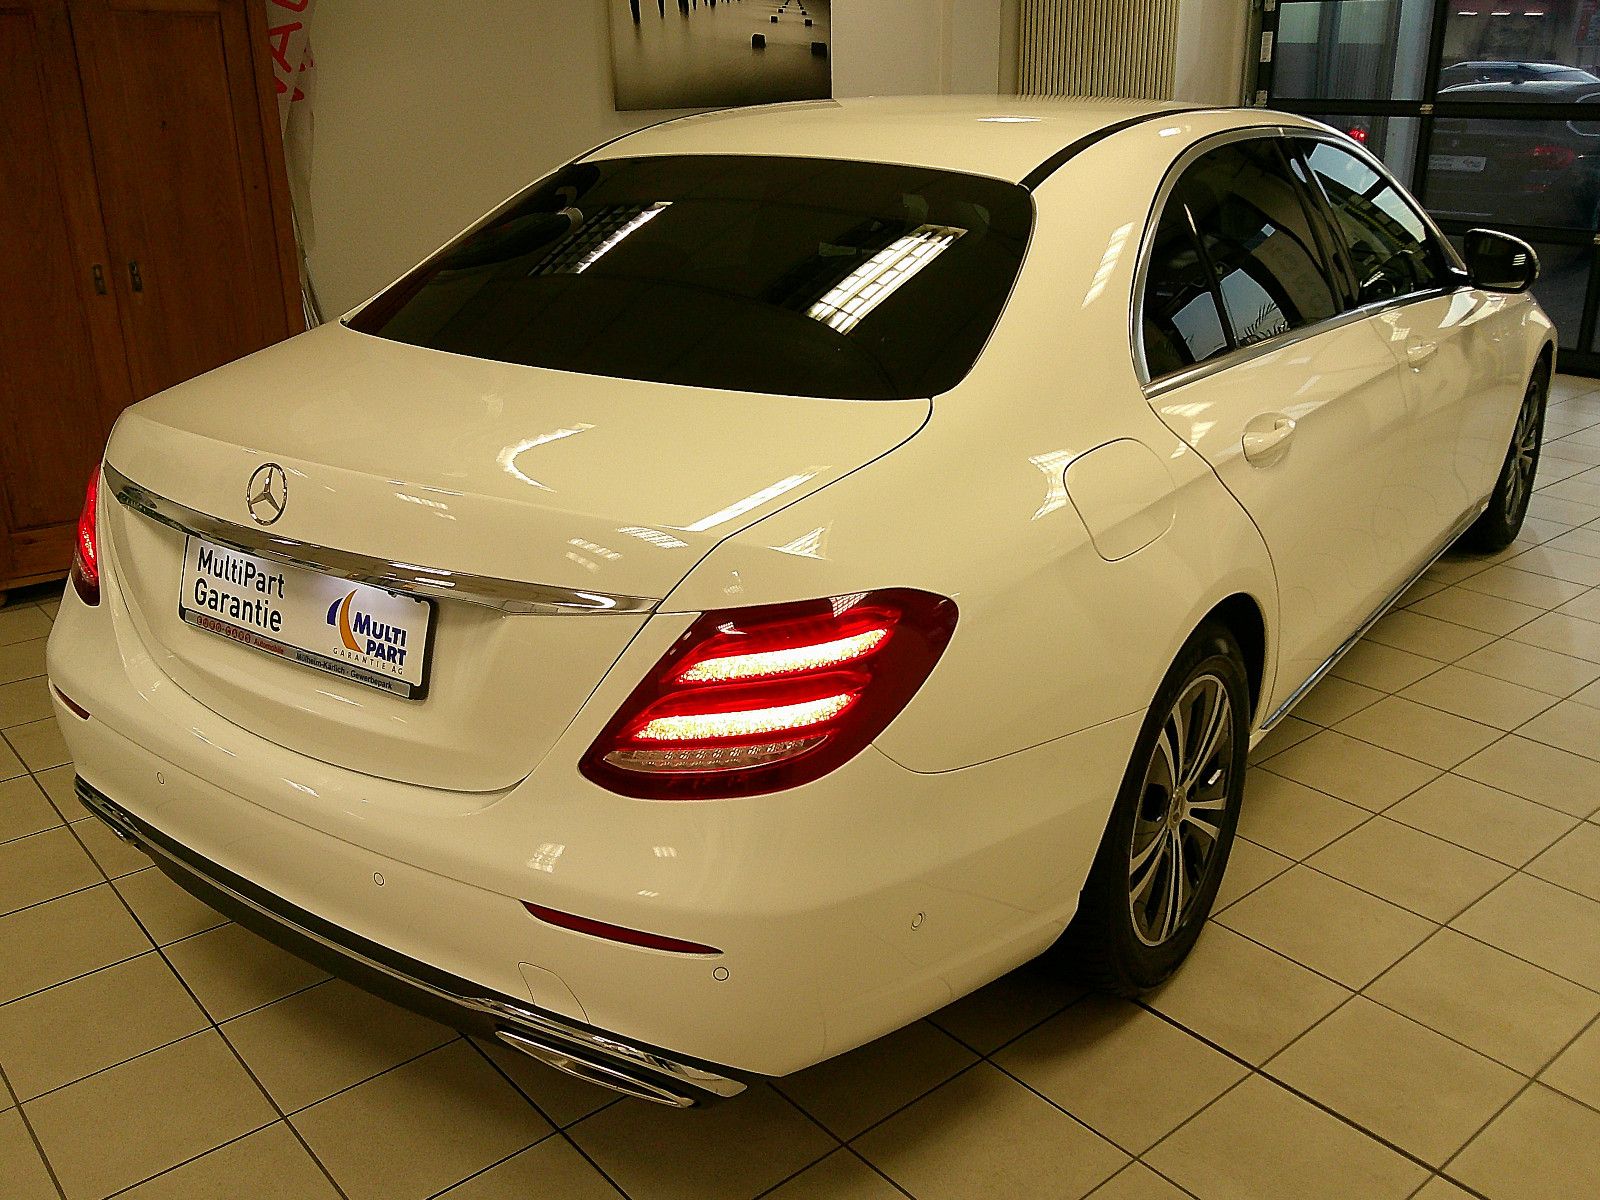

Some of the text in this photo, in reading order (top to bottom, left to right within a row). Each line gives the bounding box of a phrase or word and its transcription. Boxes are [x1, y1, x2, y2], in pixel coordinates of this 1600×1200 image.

[197, 546, 285, 599] MultiPart
[194, 578, 282, 632] Garantie
[353, 611, 407, 647] MULTI
[332, 647, 403, 675] GARANTIE AG
[366, 638, 407, 666] PART
[350, 670, 393, 690] Gewerbepark
